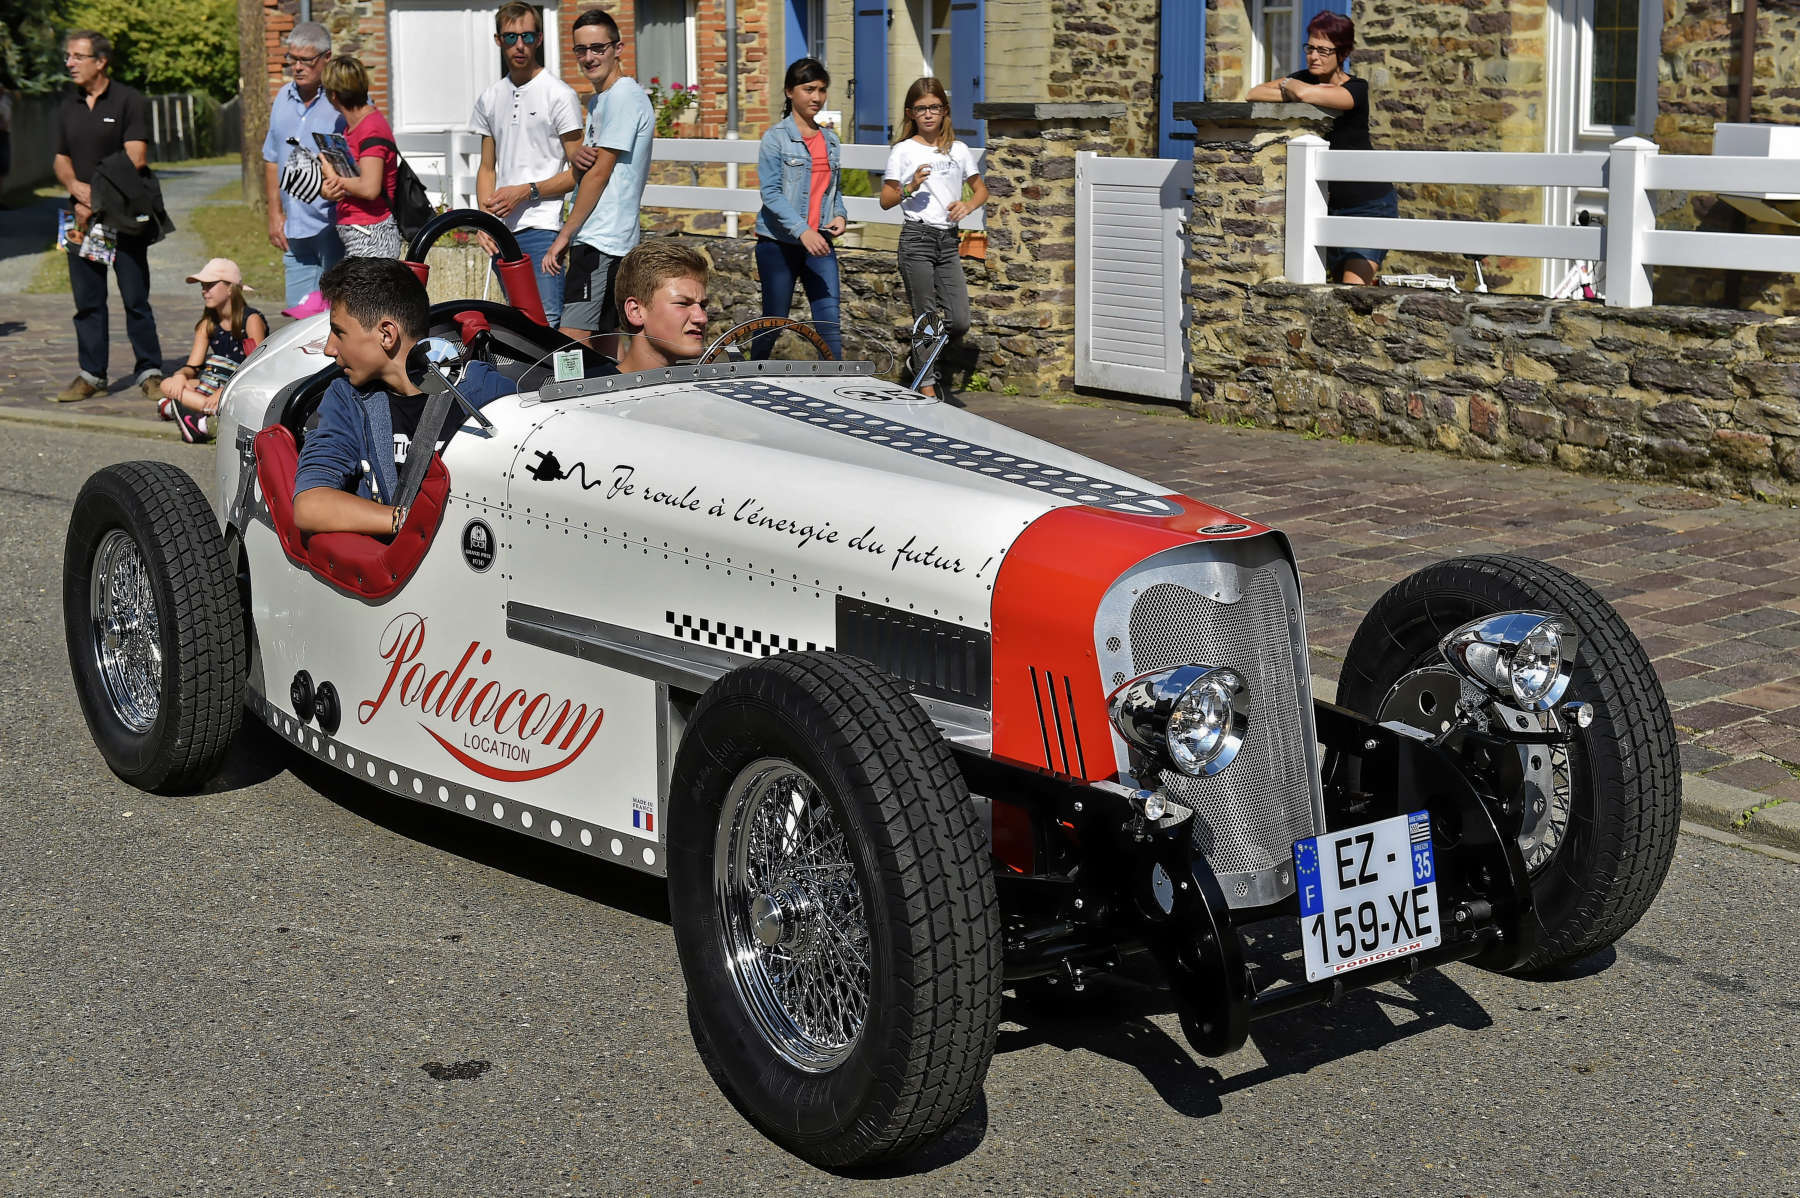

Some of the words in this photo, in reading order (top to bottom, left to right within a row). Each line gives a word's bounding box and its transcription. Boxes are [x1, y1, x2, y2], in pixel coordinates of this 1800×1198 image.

[606, 464, 635, 500] Je
[643, 486, 700, 511] roule
[708, 498, 726, 517] à
[733, 498, 839, 548] l'énergie
[848, 526, 886, 555] du
[891, 535, 965, 573] futur
[358, 612, 604, 751] Podiocom
[463, 732, 530, 764] LOCATION
[1414, 851, 1432, 880] 35
[1305, 884, 1316, 909] F
[1311, 885, 1433, 964] 159-XE
[1335, 942, 1422, 972] PODIOCOM
